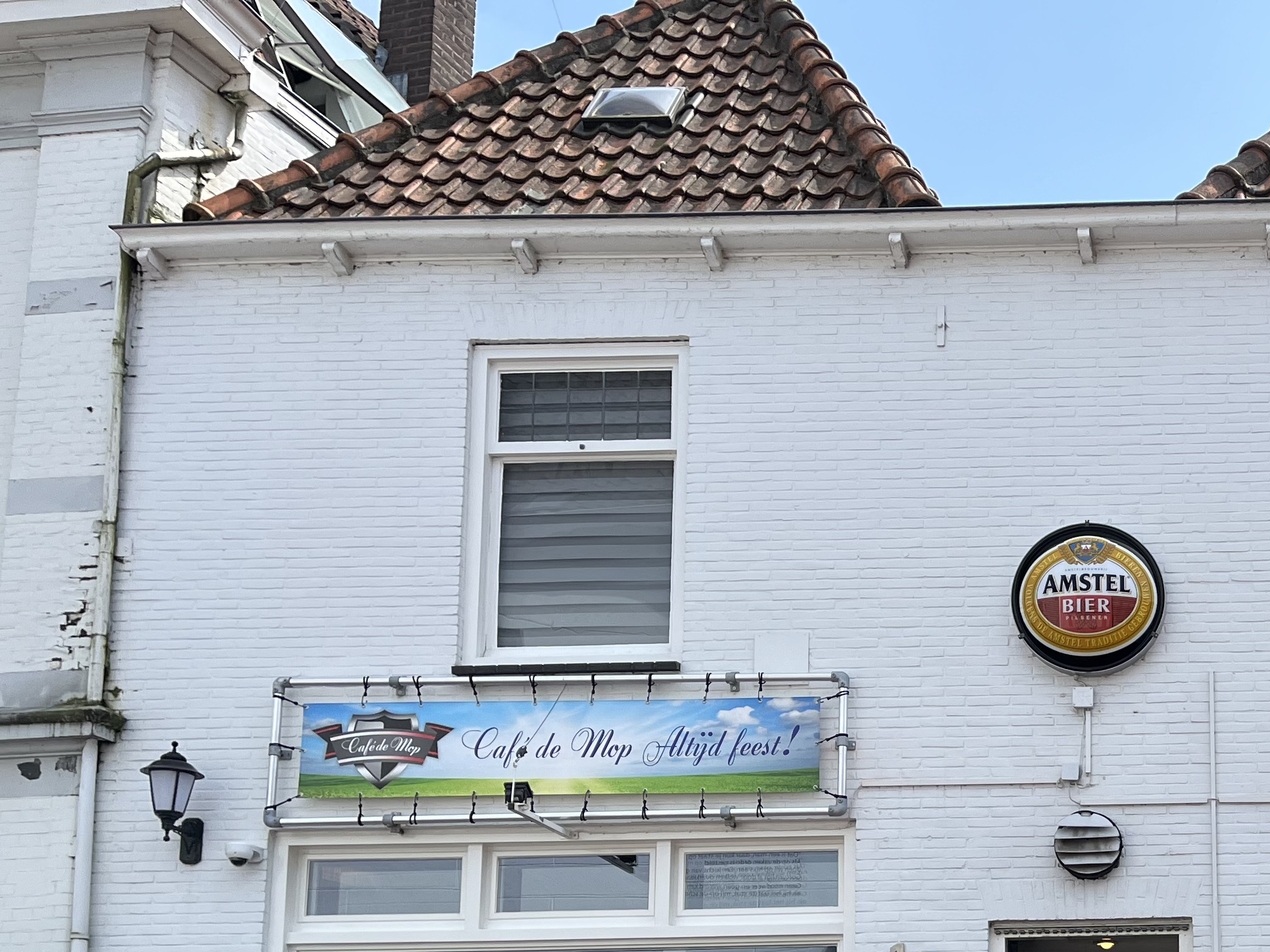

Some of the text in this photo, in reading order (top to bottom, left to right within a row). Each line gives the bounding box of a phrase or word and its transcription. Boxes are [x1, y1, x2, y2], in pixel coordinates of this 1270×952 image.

[1031, 554, 1058, 579] AMSTEL
[1043, 574, 1131, 594] AMSTEL
[1062, 598, 1110, 613] BIER
[1047, 631, 1083, 648] AMSTEL
[1086, 628, 1128, 648] TRADITIE
[341, 736, 422, 756] Café de Mop
[535, 732, 562, 759] de
[571, 727, 633, 765] Mop
[643, 725, 728, 767] Altijd
[727, 724, 801, 766] feest!
